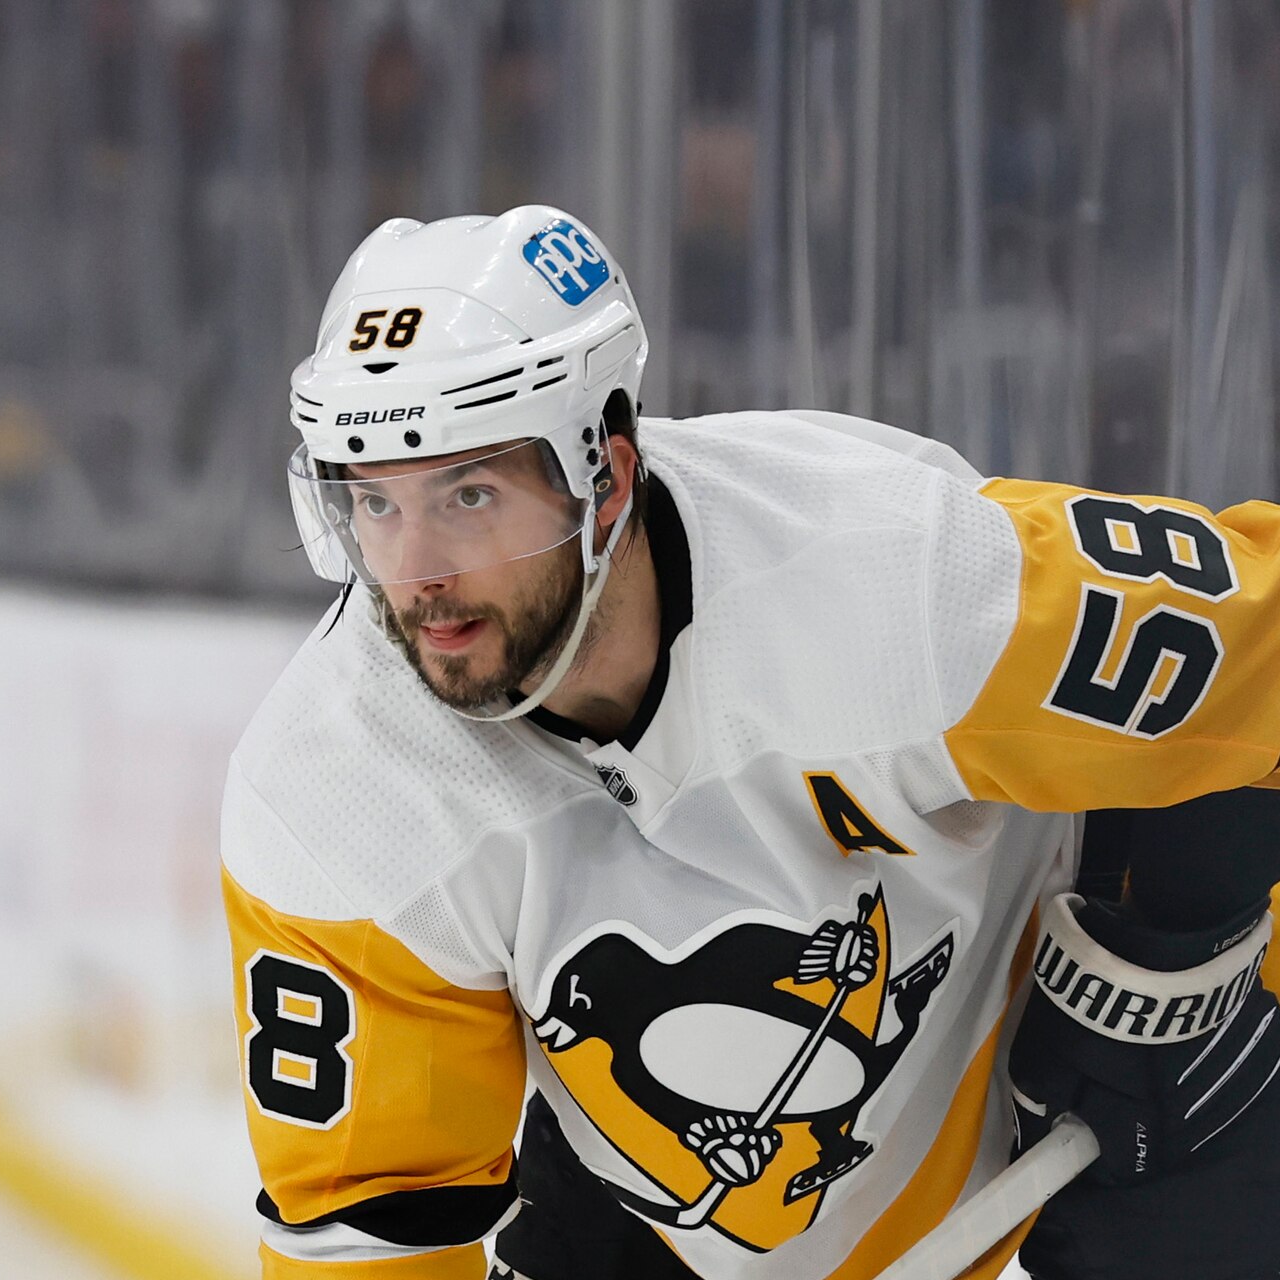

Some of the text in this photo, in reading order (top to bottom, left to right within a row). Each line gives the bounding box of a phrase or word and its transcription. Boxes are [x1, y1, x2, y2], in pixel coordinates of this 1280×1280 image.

[347, 305, 425, 354] 58
[335, 406, 426, 426] BAUER
[1041, 493, 1241, 741] 58
[801, 770, 918, 858] A
[244, 947, 357, 1131] 8
[1135, 1121, 1147, 1173] ALPHA
